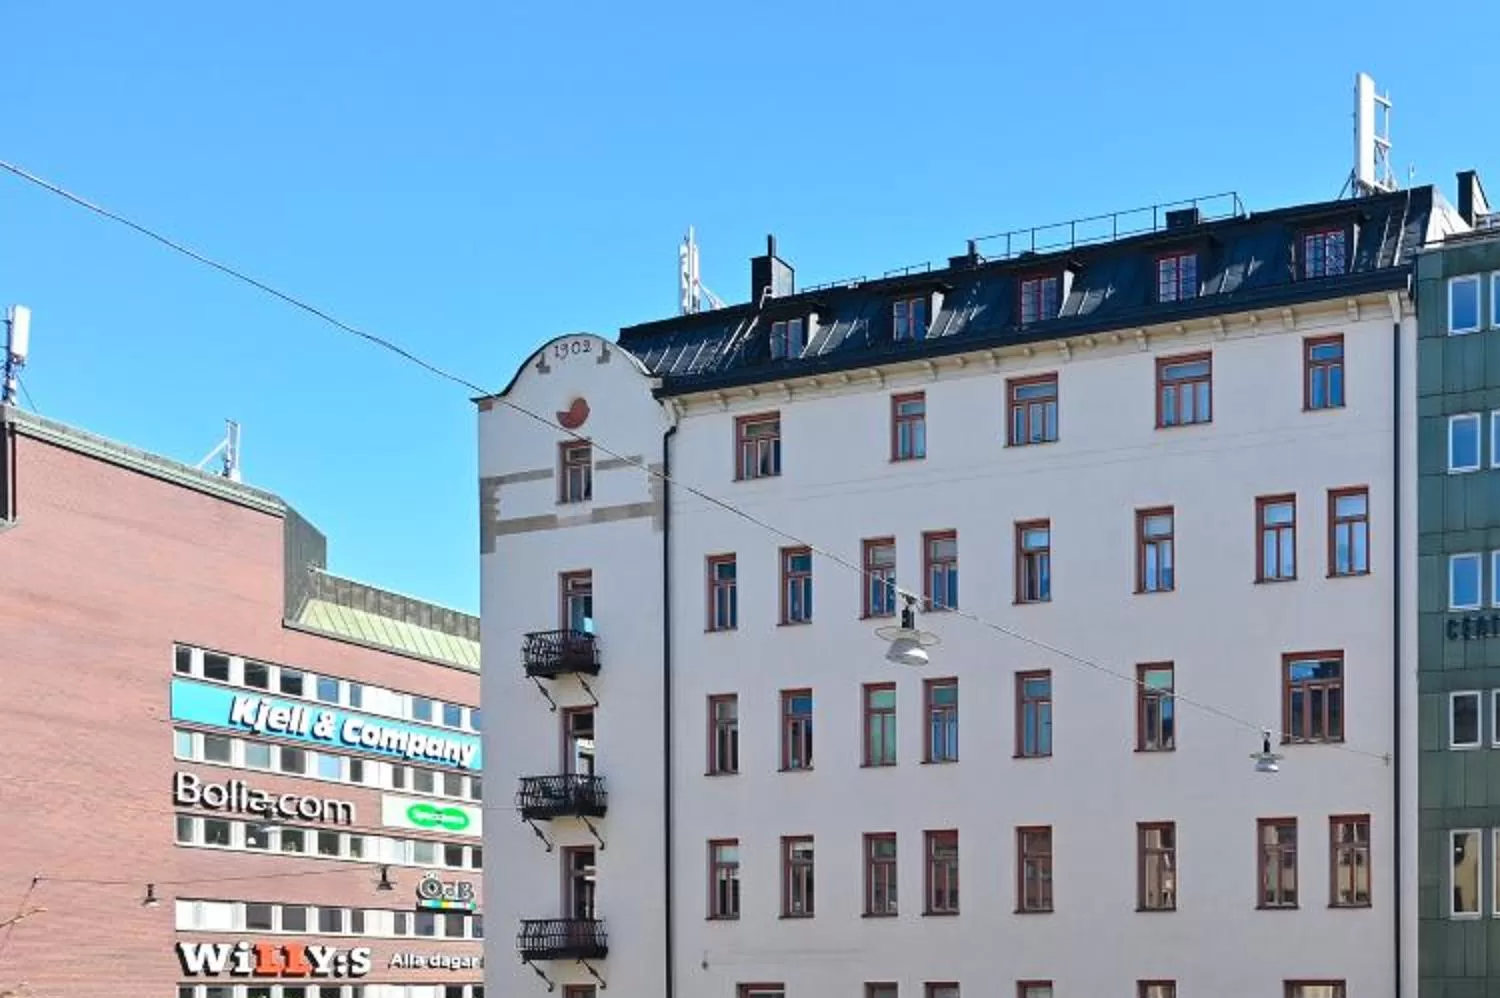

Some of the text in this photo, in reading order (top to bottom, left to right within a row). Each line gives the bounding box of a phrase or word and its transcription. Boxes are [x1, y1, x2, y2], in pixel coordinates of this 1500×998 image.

[230, 695, 478, 769] Kjell & Company
[389, 952, 479, 971] Alla dagar
